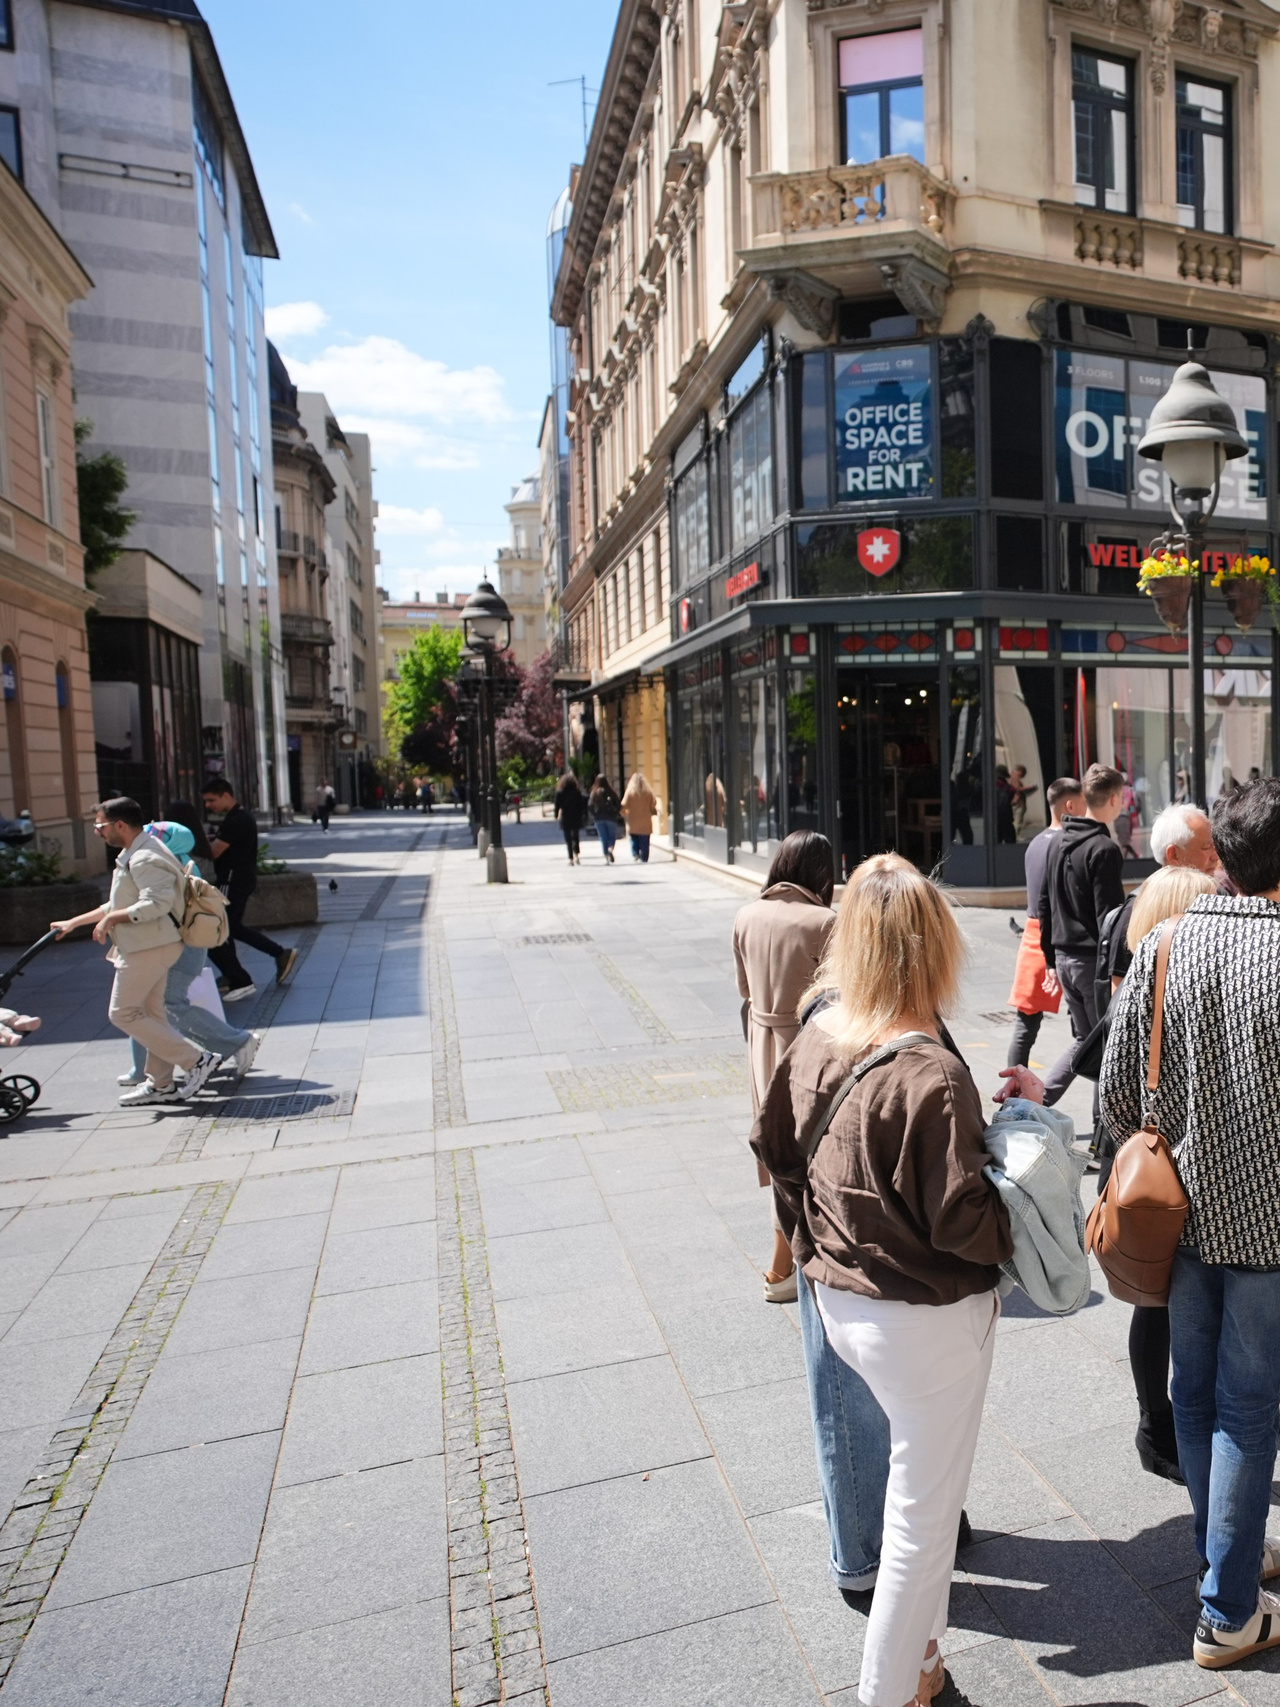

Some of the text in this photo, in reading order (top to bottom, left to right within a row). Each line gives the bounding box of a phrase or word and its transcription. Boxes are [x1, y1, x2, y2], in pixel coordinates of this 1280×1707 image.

[1075, 366, 1114, 380] FLOORS
[844, 402, 923, 427] OFFICE
[845, 423, 924, 450] SPACE
[1065, 410, 1260, 474] OFE
[868, 448, 901, 464] FOR
[846, 461, 924, 493] RENT
[1137, 468, 1260, 511] SCE
